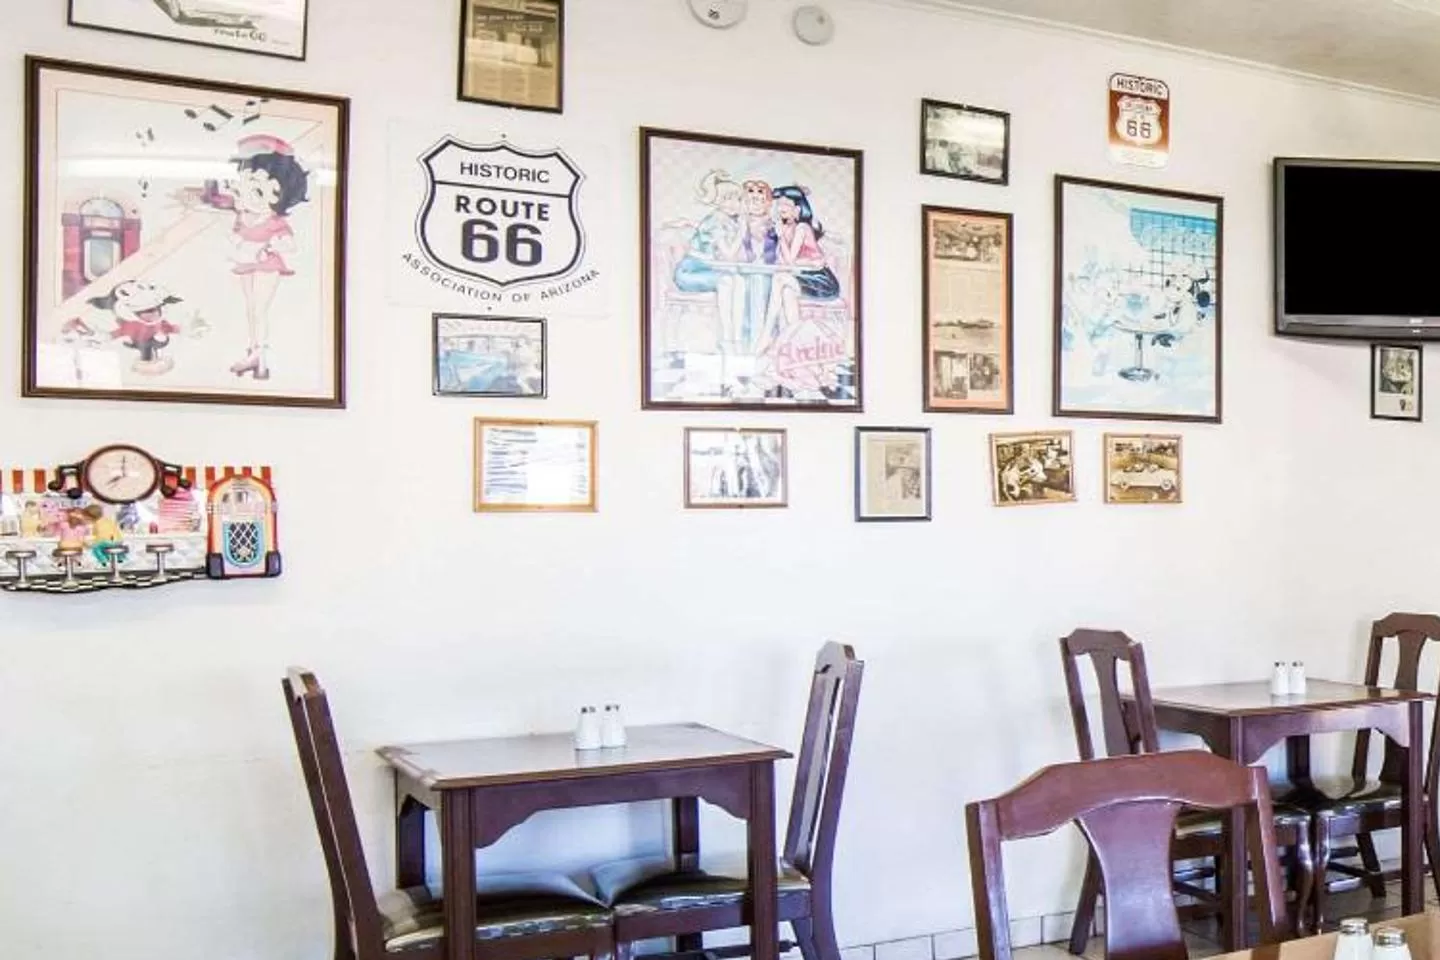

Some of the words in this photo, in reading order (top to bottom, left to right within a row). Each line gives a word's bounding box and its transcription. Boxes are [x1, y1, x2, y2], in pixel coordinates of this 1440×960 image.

[1116, 78, 1163, 96] HISTORIC
[1127, 120, 1151, 139] 66
[460, 162, 550, 183] HISTORIC
[455, 195, 550, 221] ROUTE
[461, 218, 542, 267] 66
[402, 252, 502, 302] ASSOCIATION
[512, 293, 531, 303] OF
[540, 268, 600, 301] ARIZONA
